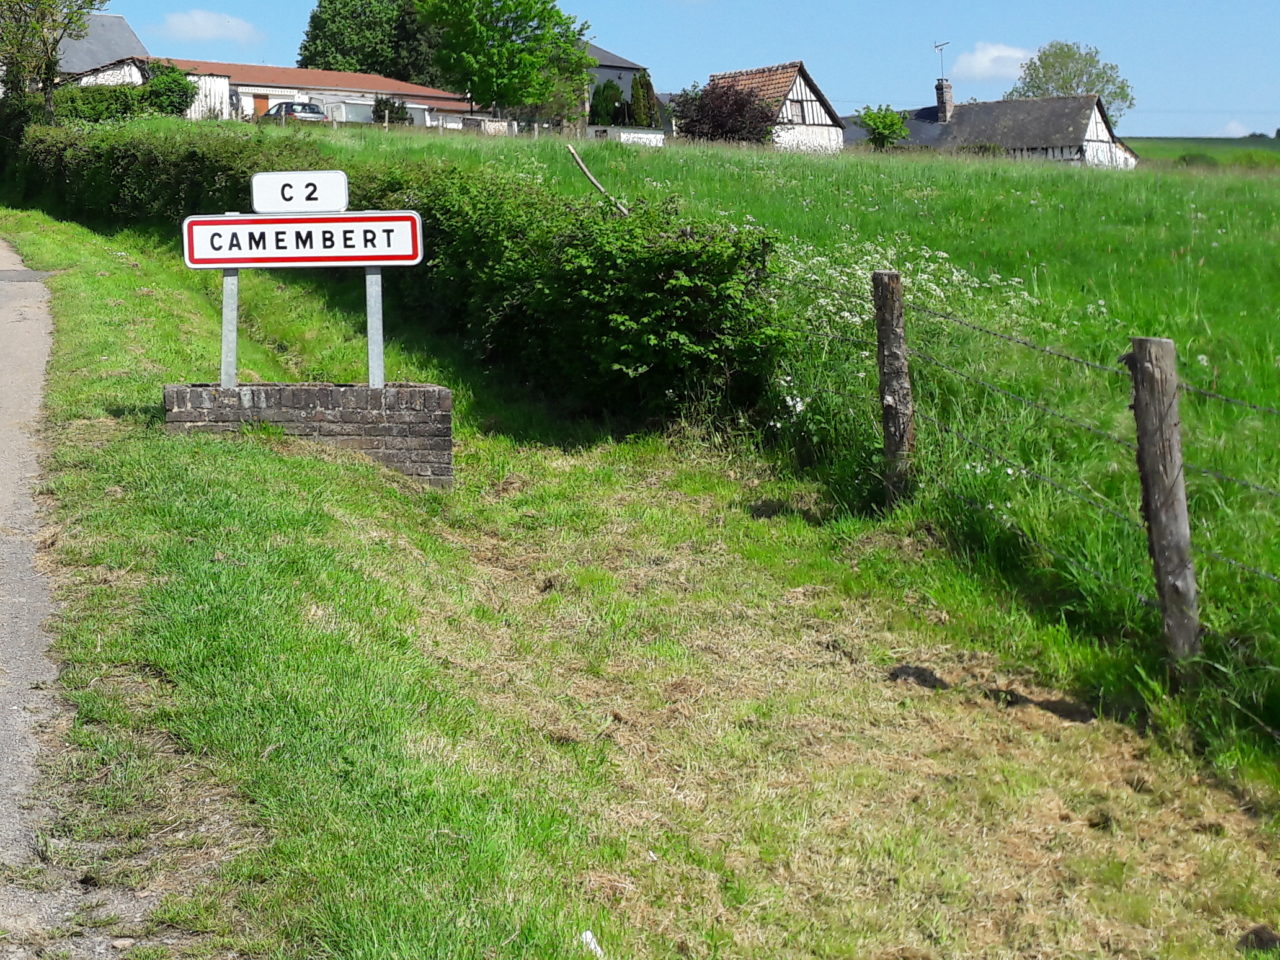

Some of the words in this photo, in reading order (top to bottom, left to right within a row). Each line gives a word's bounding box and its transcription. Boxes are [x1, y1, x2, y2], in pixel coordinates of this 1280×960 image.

[280, 183, 294, 202] C
[304, 182, 319, 201] 2
[209, 229, 395, 251] CAMEMBERT
